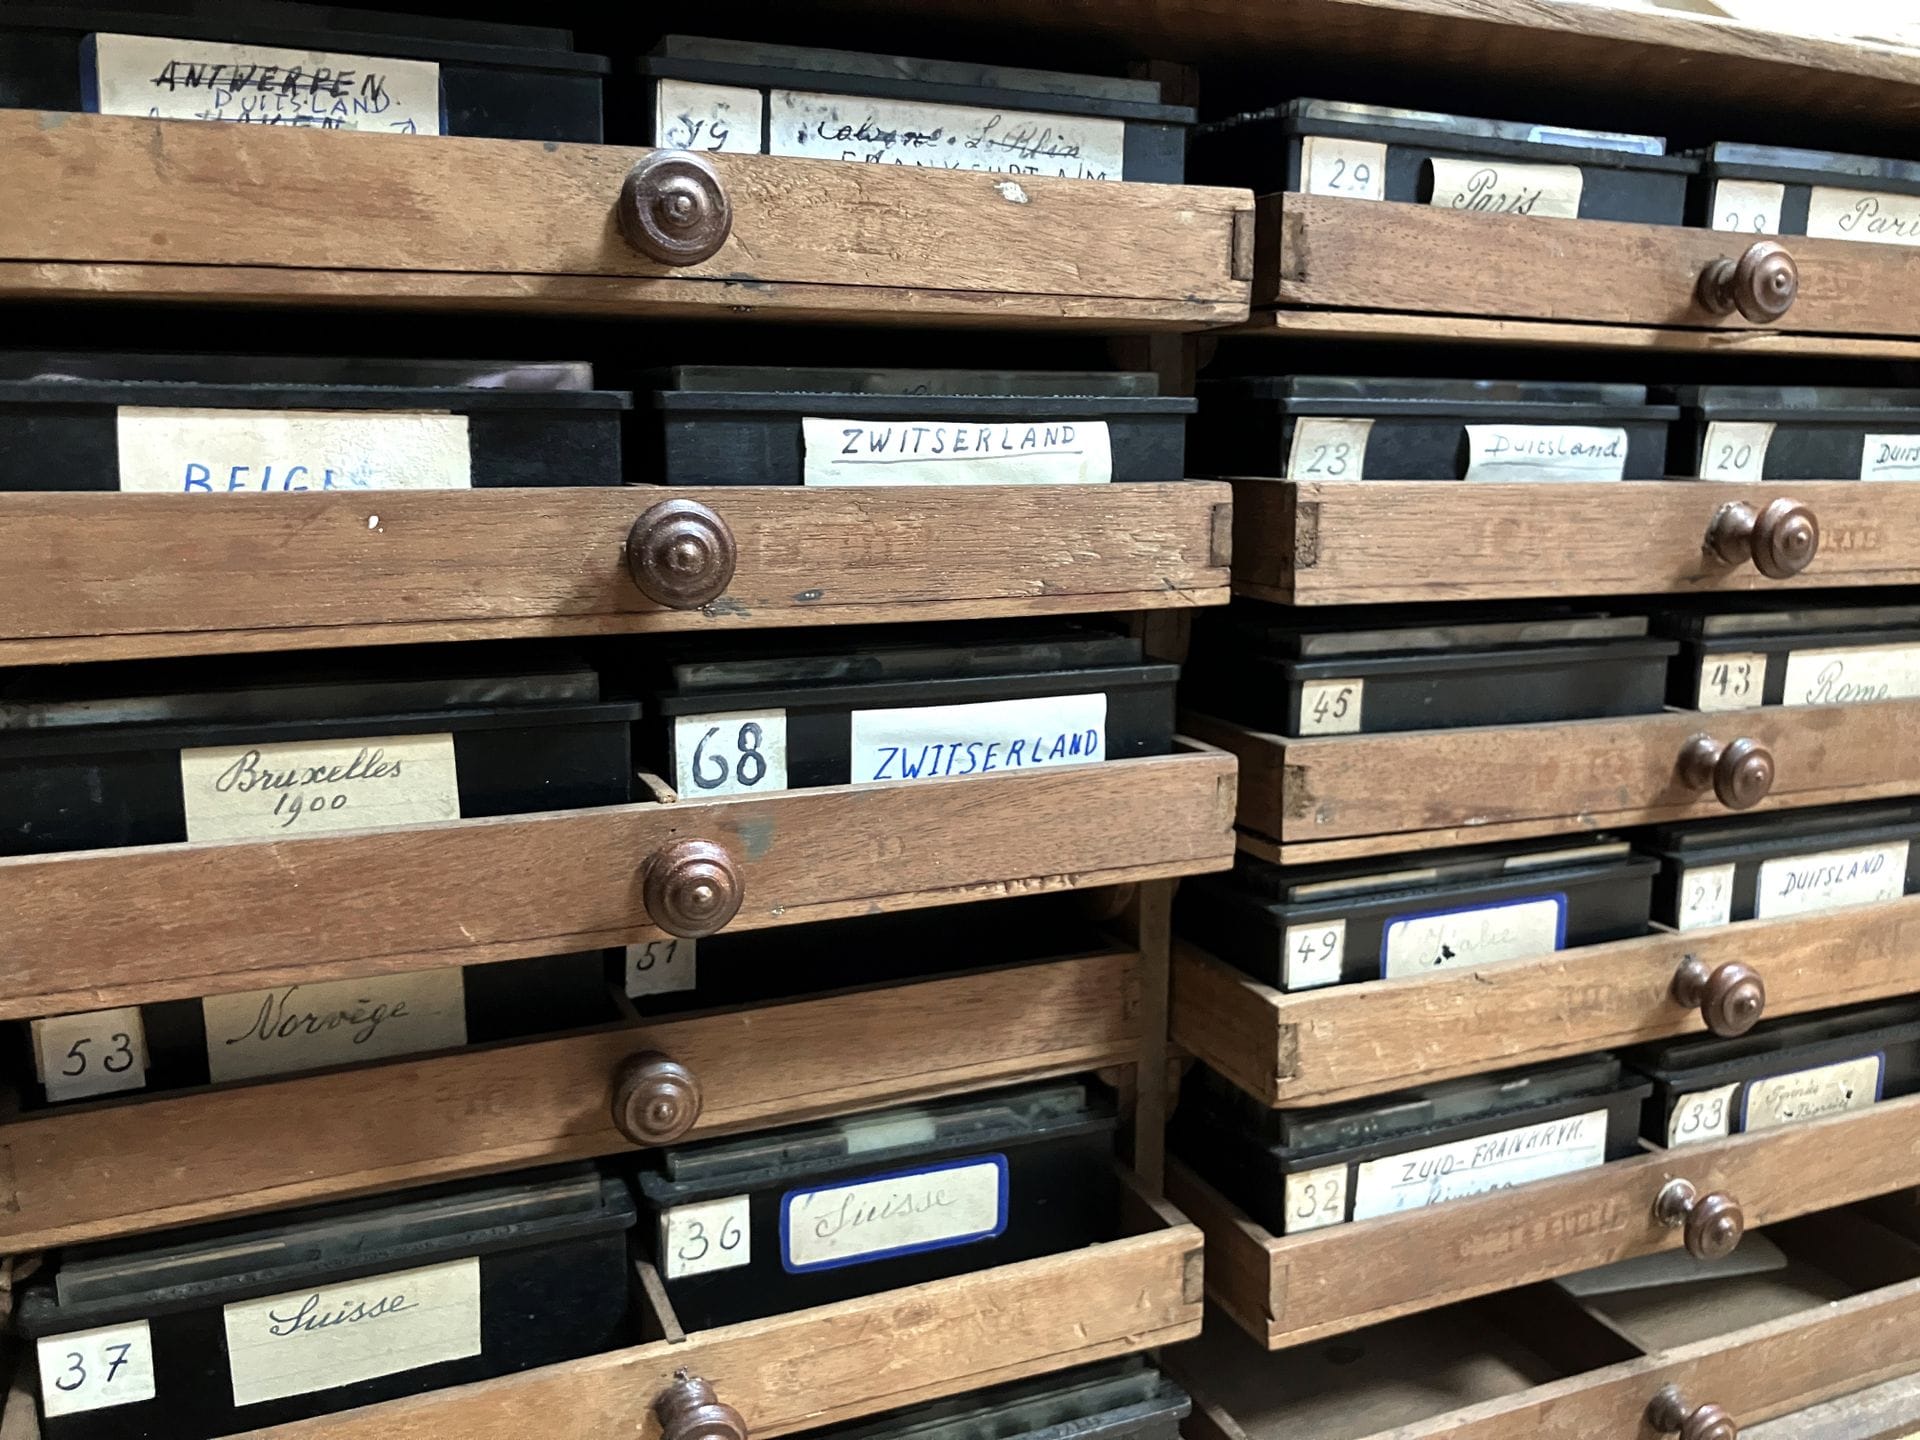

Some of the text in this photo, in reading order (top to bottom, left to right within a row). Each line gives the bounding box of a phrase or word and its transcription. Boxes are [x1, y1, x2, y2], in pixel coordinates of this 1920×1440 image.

[156, 60, 387, 100] ANTWERPEN
[842, 425, 1076, 453] ZWITSERLAND
[1306, 442, 1351, 475] 23
[1717, 444, 1752, 470] 20
[1711, 663, 1752, 697] 43
[1313, 687, 1354, 723] 45
[216, 750, 402, 792] Bruxelles
[692, 722, 768, 790] 68
[873, 729, 1099, 781] ZWITSERLAND
[273, 793, 348, 828] 1900
[1778, 853, 1885, 897] DUITSLAND
[1297, 930, 1338, 963] 49
[62, 1032, 134, 1076] 53
[1681, 1097, 1724, 1134] 33
[1296, 1178, 1340, 1218] 32
[678, 1215, 742, 1261] 36
[268, 1293, 420, 1337] Suisse
[56, 1343, 132, 1391] 37
